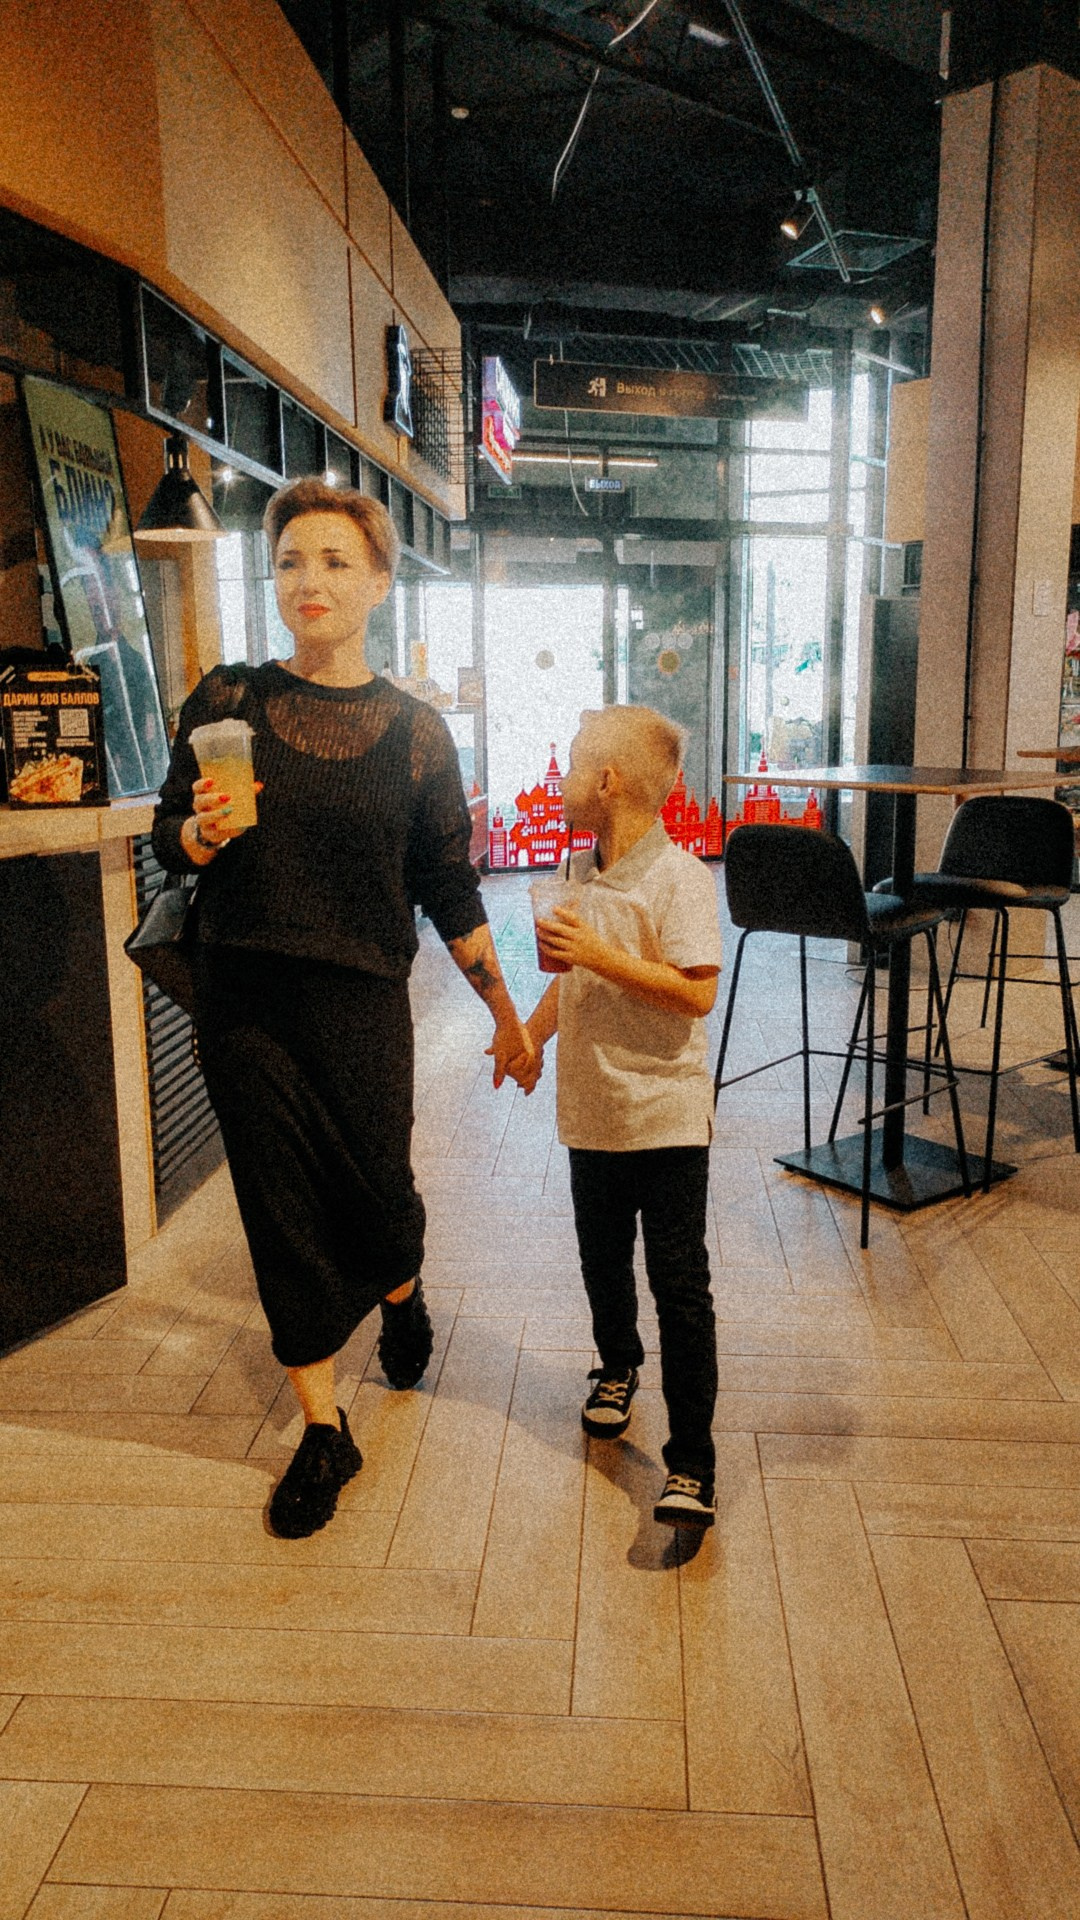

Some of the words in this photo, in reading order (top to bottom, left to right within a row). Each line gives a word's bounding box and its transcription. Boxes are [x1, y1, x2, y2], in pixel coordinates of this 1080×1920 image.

[616, 382, 656, 398] Выход
[589, 479, 620, 489] ВЫХОД
[3, 693, 38, 707] ДАРИМ
[40, 693, 59, 705] 200
[61, 692, 99, 705] БАЛЛОВ
